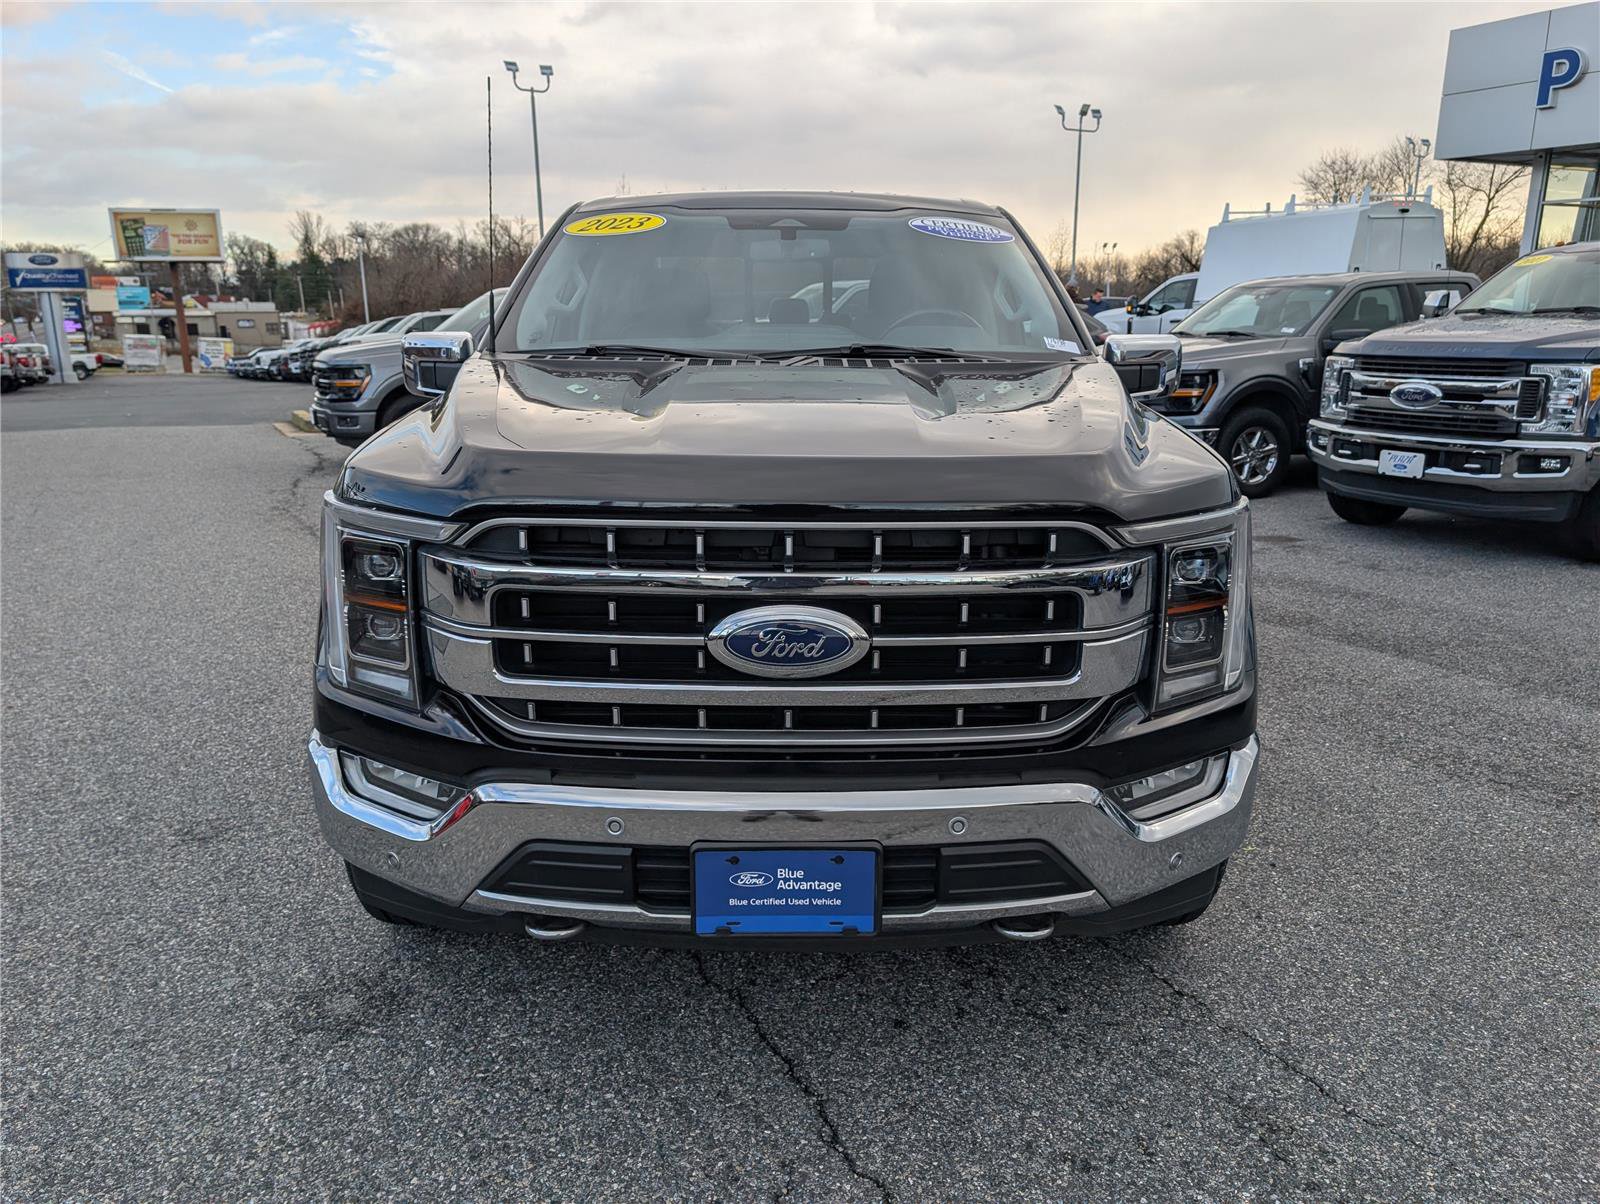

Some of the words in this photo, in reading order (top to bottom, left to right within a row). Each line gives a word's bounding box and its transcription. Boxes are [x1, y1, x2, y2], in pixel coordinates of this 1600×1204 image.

[1536, 47, 1585, 109] P
[577, 216, 652, 232] 2023
[920, 219, 1001, 235] CERTIFIED
[1401, 388, 1426, 401] Ford
[1388, 454, 1416, 465] PLAZA
[751, 627, 826, 658] Ford
[737, 873, 765, 885] Ford
[777, 868, 804, 879] Blue
[777, 880, 842, 892] Advantage
[729, 898, 748, 906] Blue
[750, 898, 786, 906] Certified
[788, 898, 810, 906] Used
[812, 898, 842, 906] Vehicle
